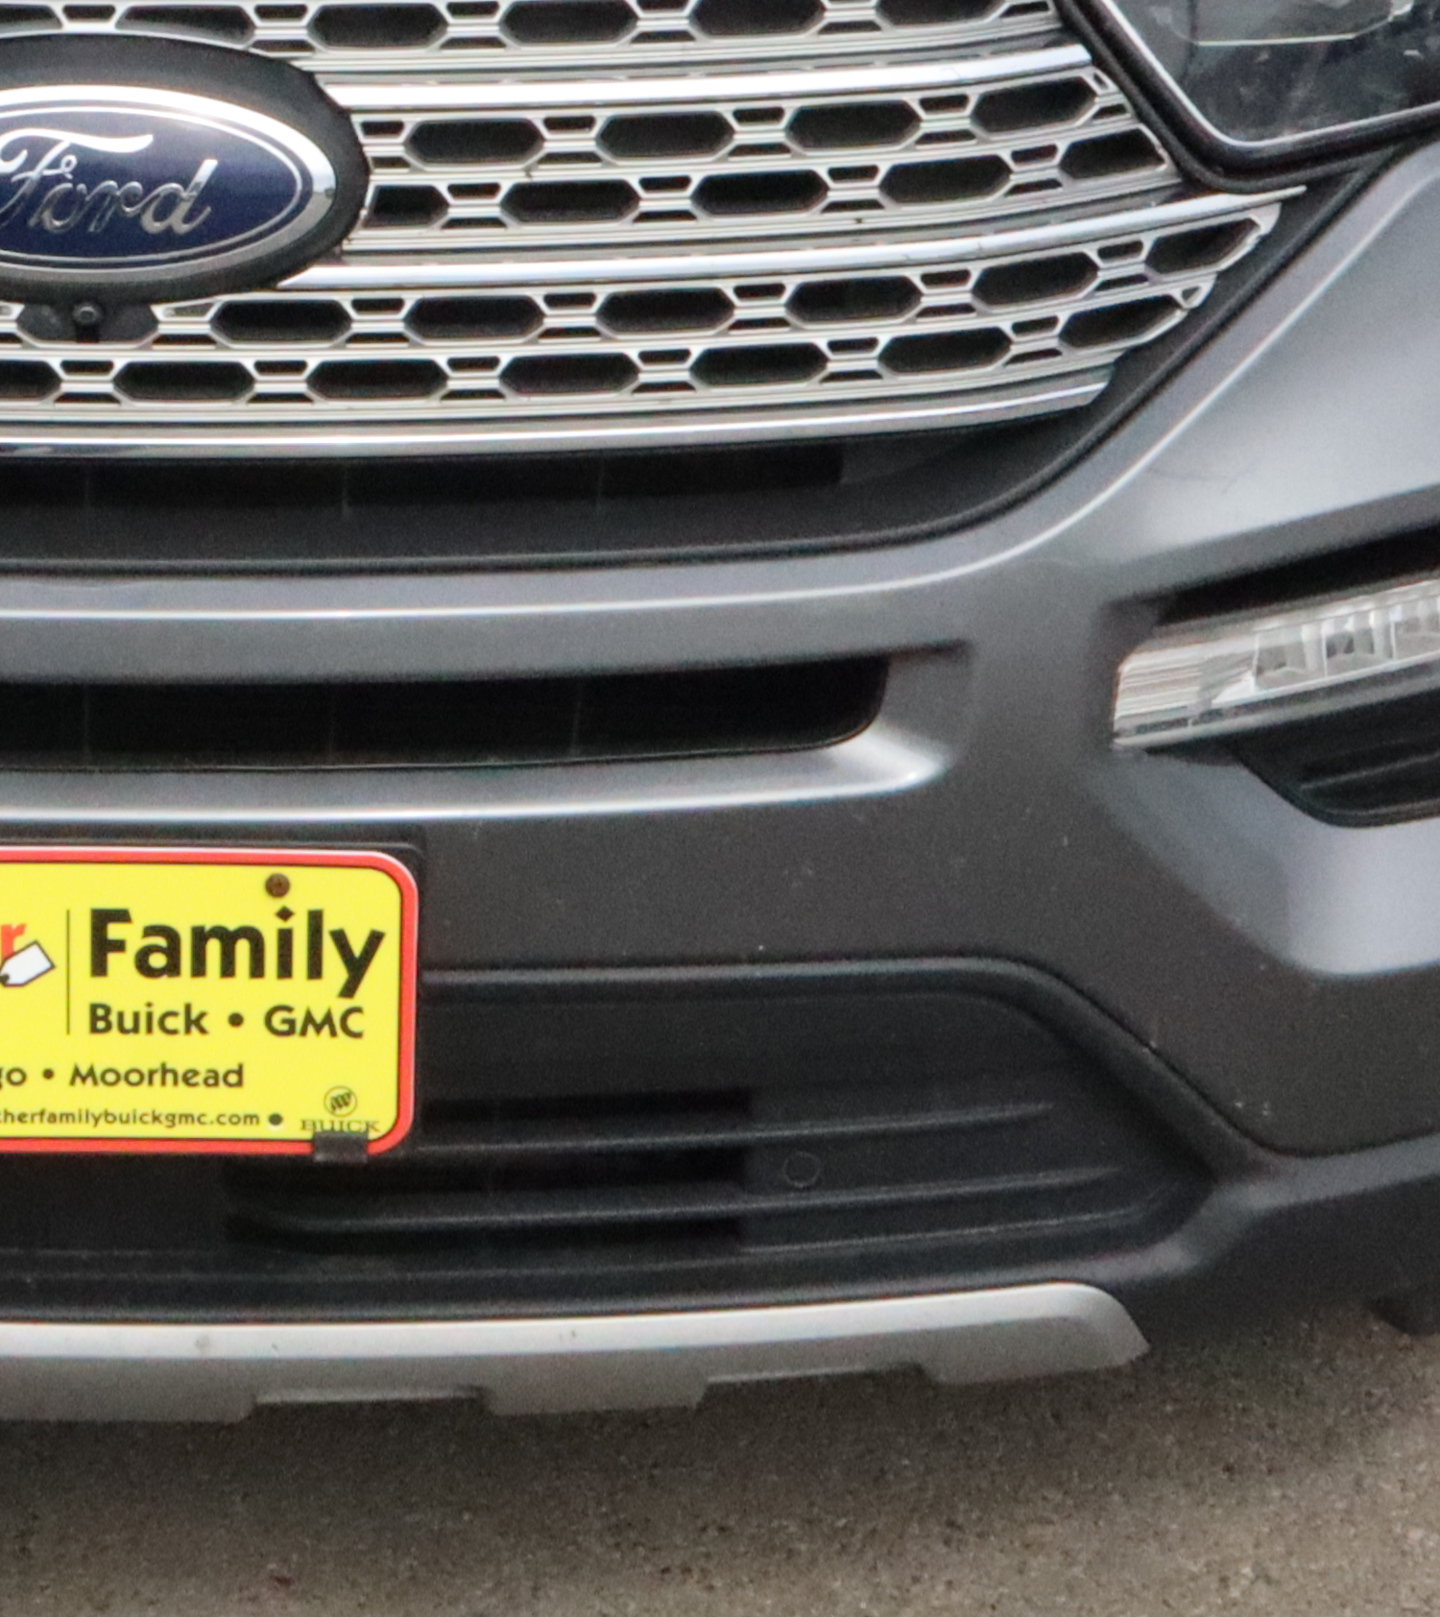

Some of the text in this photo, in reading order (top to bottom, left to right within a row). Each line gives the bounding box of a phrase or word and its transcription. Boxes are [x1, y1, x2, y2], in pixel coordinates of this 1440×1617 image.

[90, 906, 386, 999] Family
[89, 1002, 364, 1039] Buick GMC
[70, 1062, 244, 1088] Moorhead
[300, 1118, 380, 1133] BUICK
